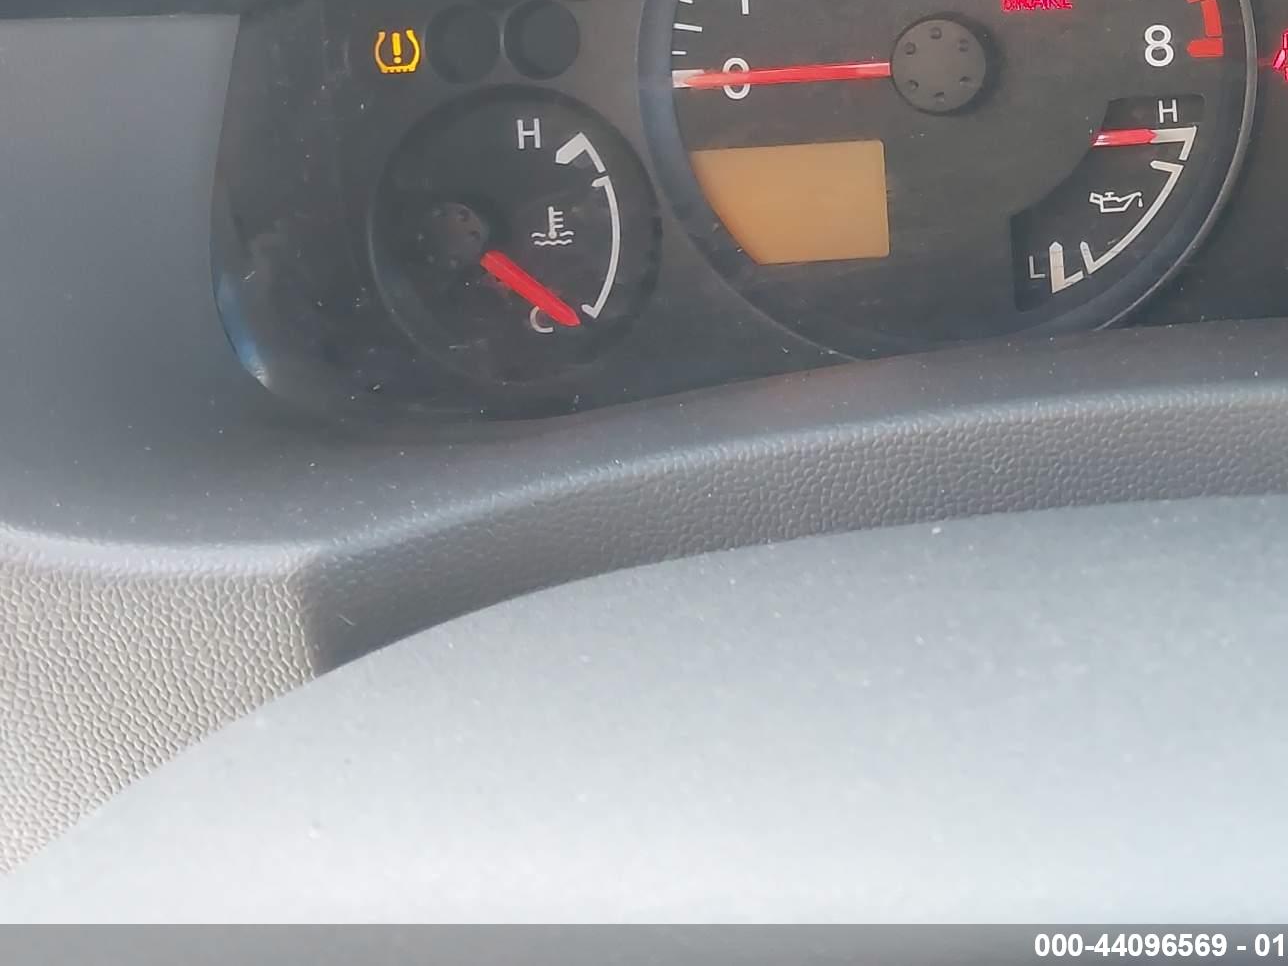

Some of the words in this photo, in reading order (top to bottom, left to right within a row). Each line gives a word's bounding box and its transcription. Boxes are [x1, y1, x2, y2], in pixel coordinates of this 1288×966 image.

[1146, 25, 1174, 67] 8
[722, 57, 751, 100] 0
[1158, 99, 1178, 123] H
[516, 118, 541, 150] H
[1030, 256, 1046, 279] L
